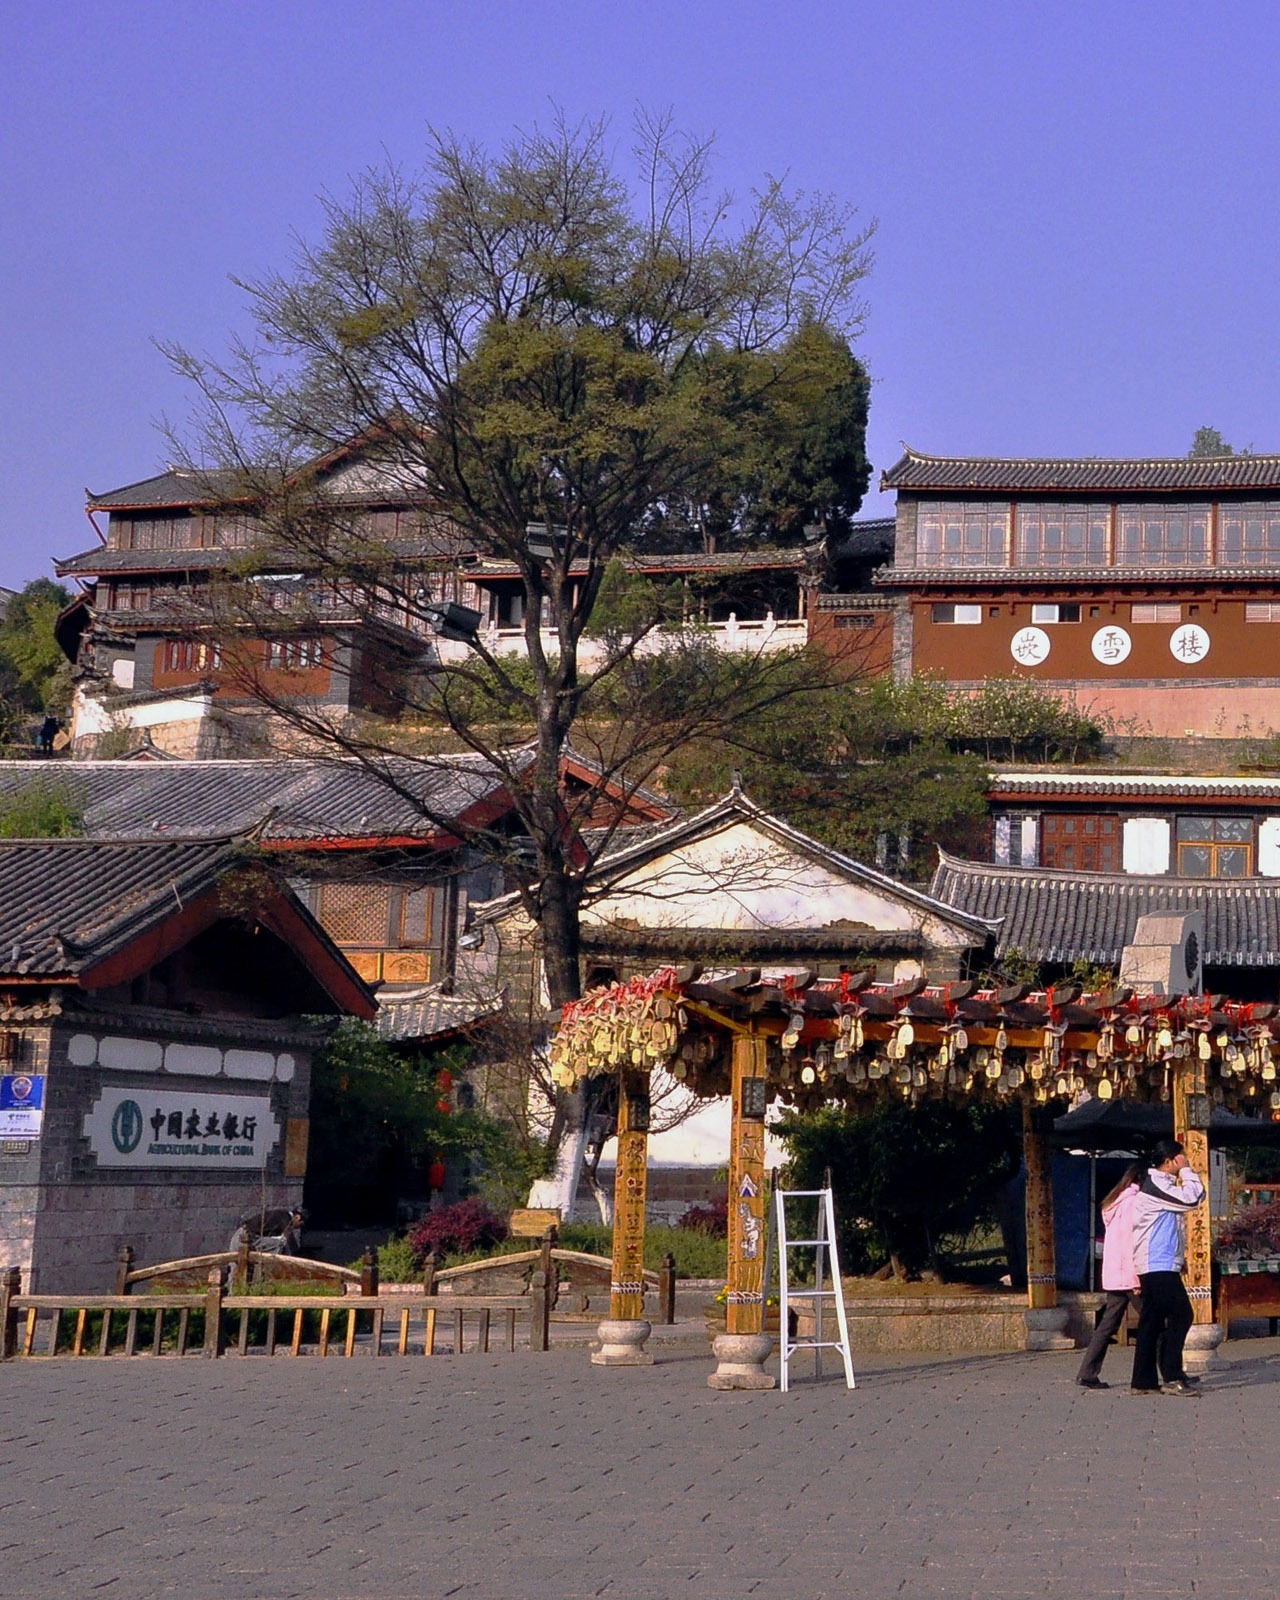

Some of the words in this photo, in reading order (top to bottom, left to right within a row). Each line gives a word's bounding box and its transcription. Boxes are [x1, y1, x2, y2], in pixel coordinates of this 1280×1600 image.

[1015, 630, 1202, 659] 嵌雪楼
[150, 1107, 258, 1142] 中国农业银行
[147, 1143, 201, 1155] AGRICULTURAL
[202, 1143, 221, 1156] BANK
[222, 1145, 232, 1156] OF
[233, 1145, 254, 1156] CHINA
